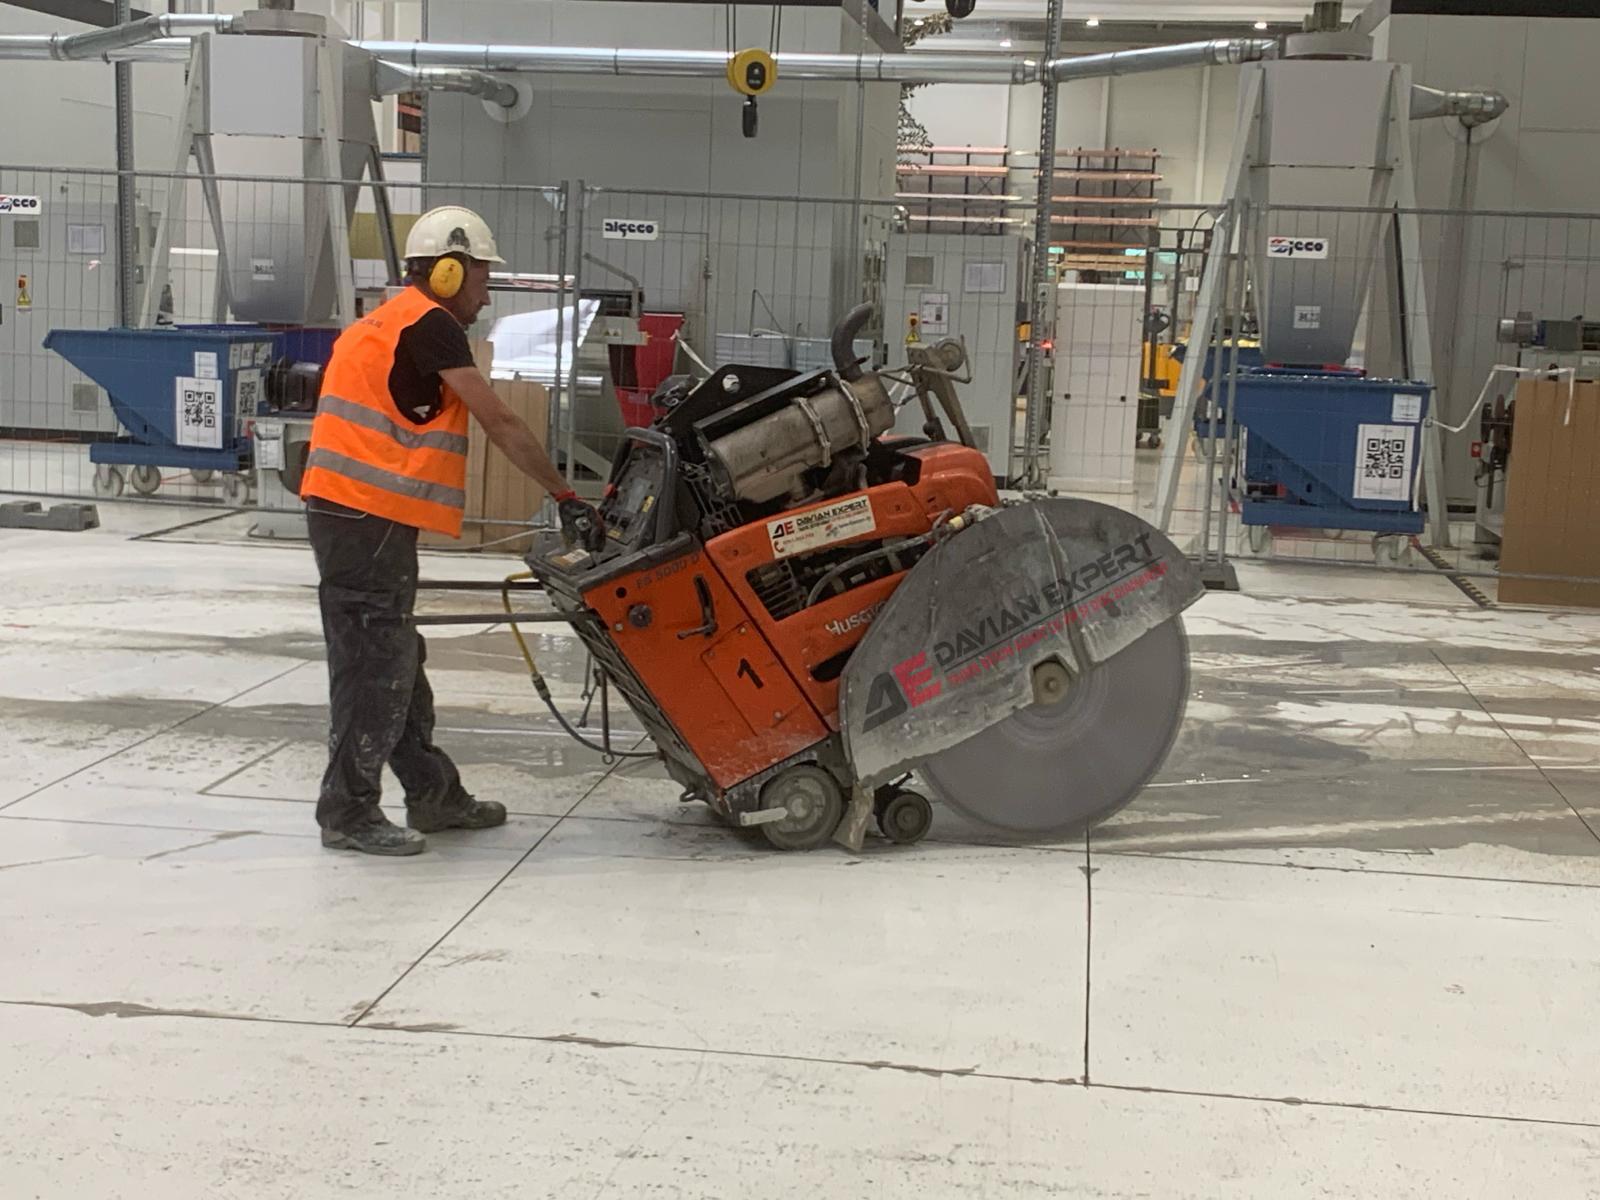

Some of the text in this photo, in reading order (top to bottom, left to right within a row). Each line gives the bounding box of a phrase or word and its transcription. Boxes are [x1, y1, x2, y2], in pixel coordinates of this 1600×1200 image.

[796, 510, 831, 526] DAVIAN
[832, 499, 867, 516] EXPERT
[933, 532, 1155, 667] DAVIAN EXPERT
[737, 658, 764, 689] 1
